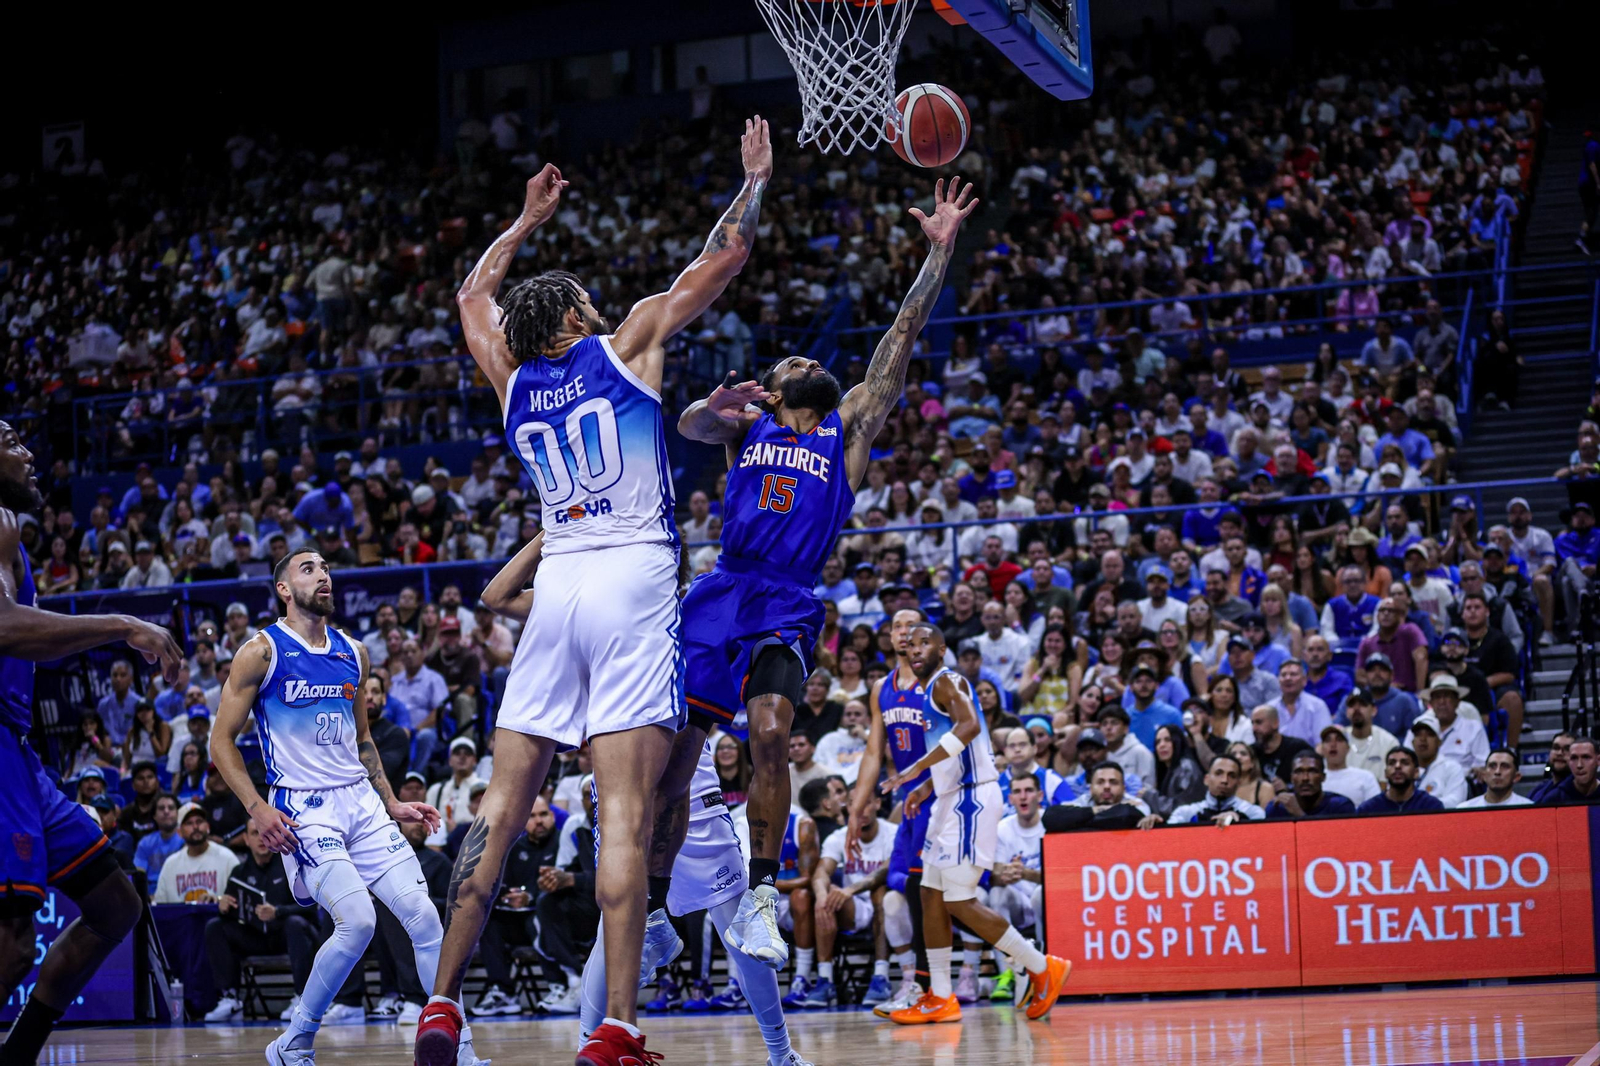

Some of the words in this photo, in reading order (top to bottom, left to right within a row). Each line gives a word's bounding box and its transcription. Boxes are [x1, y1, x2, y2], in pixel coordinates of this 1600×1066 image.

[529, 374, 586, 412] MCGEE
[515, 397, 623, 506] 00
[739, 442, 831, 483] SANTURCE
[757, 473, 798, 514] 15
[285, 679, 358, 703] VAQUERO
[315, 711, 344, 746] 27
[882, 707, 923, 727] SANTURCE
[895, 727, 911, 751] 31
[386, 840, 409, 854] Libert
[711, 869, 742, 893] Liberty
[1081, 857, 1263, 903] DOCTORS'
[1303, 852, 1549, 899] ORLANDO
[1082, 899, 1259, 927] CENTER
[1084, 923, 1267, 961] HOSPITAL
